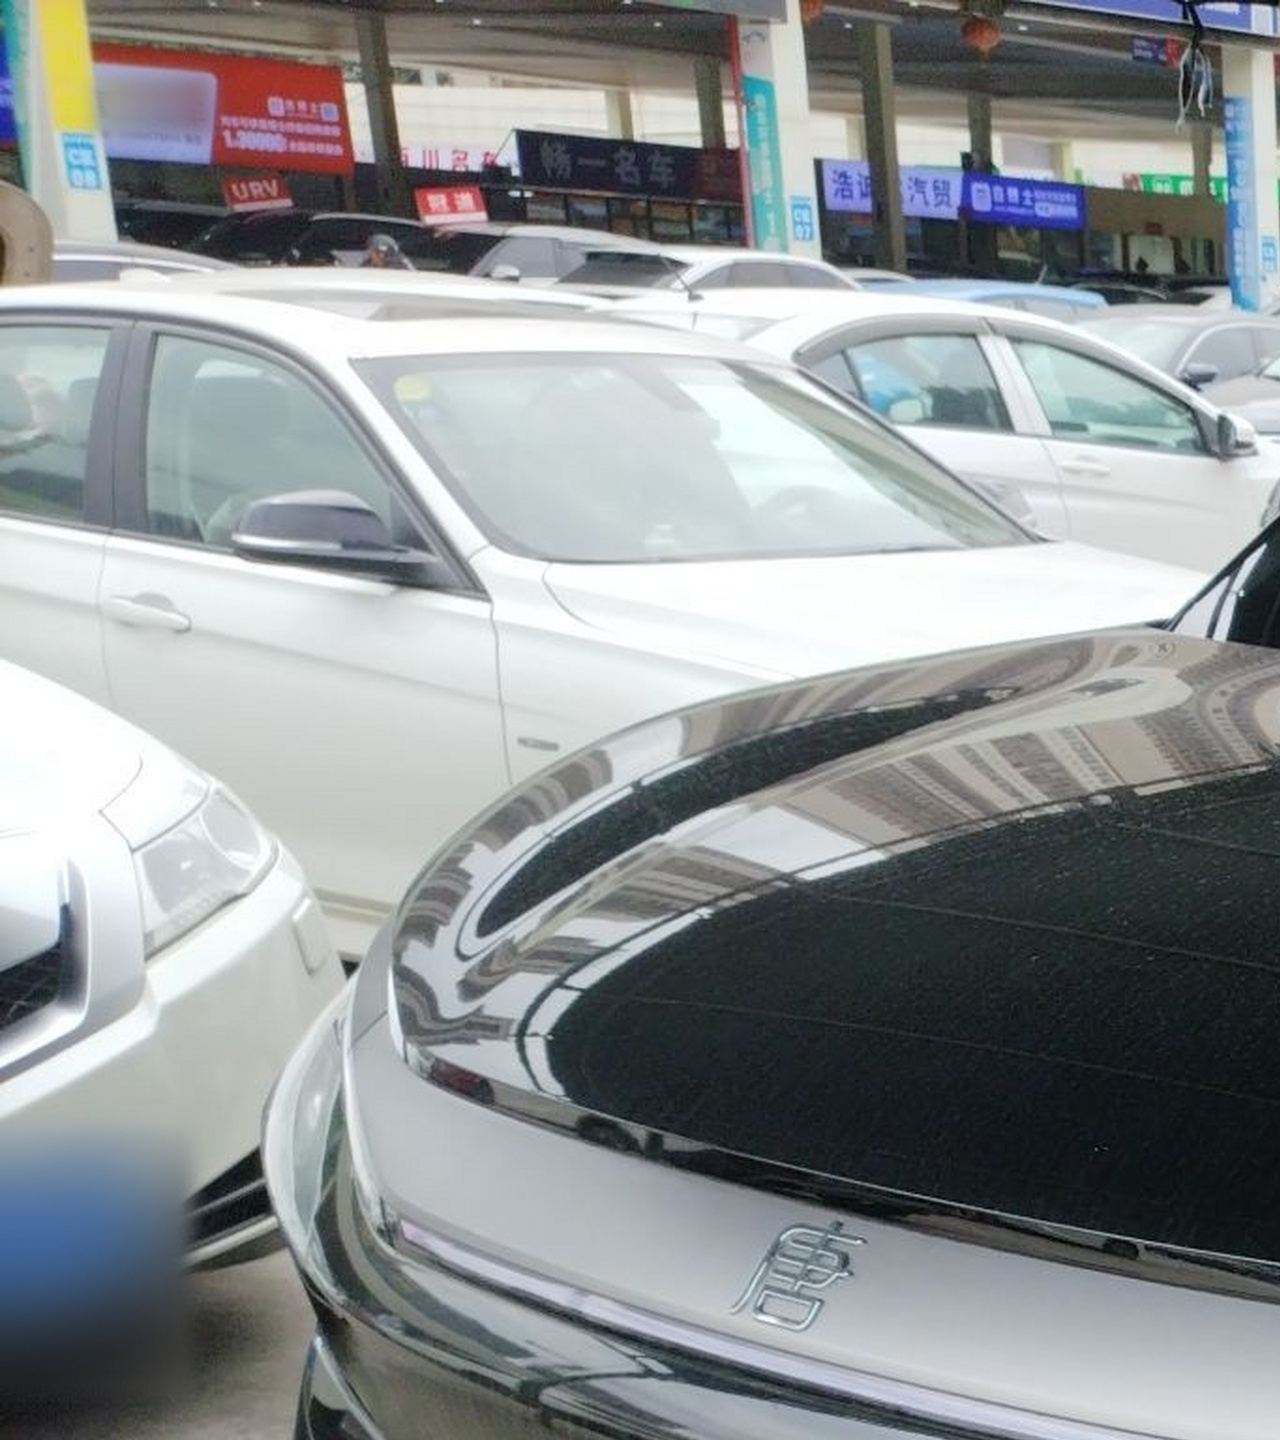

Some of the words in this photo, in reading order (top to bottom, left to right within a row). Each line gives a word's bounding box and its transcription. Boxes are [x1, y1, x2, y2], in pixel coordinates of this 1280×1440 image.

[230, 180, 279, 200] URV
[541, 137, 676, 190] 畅一名车
[730, 1220, 868, 1333] 唐
